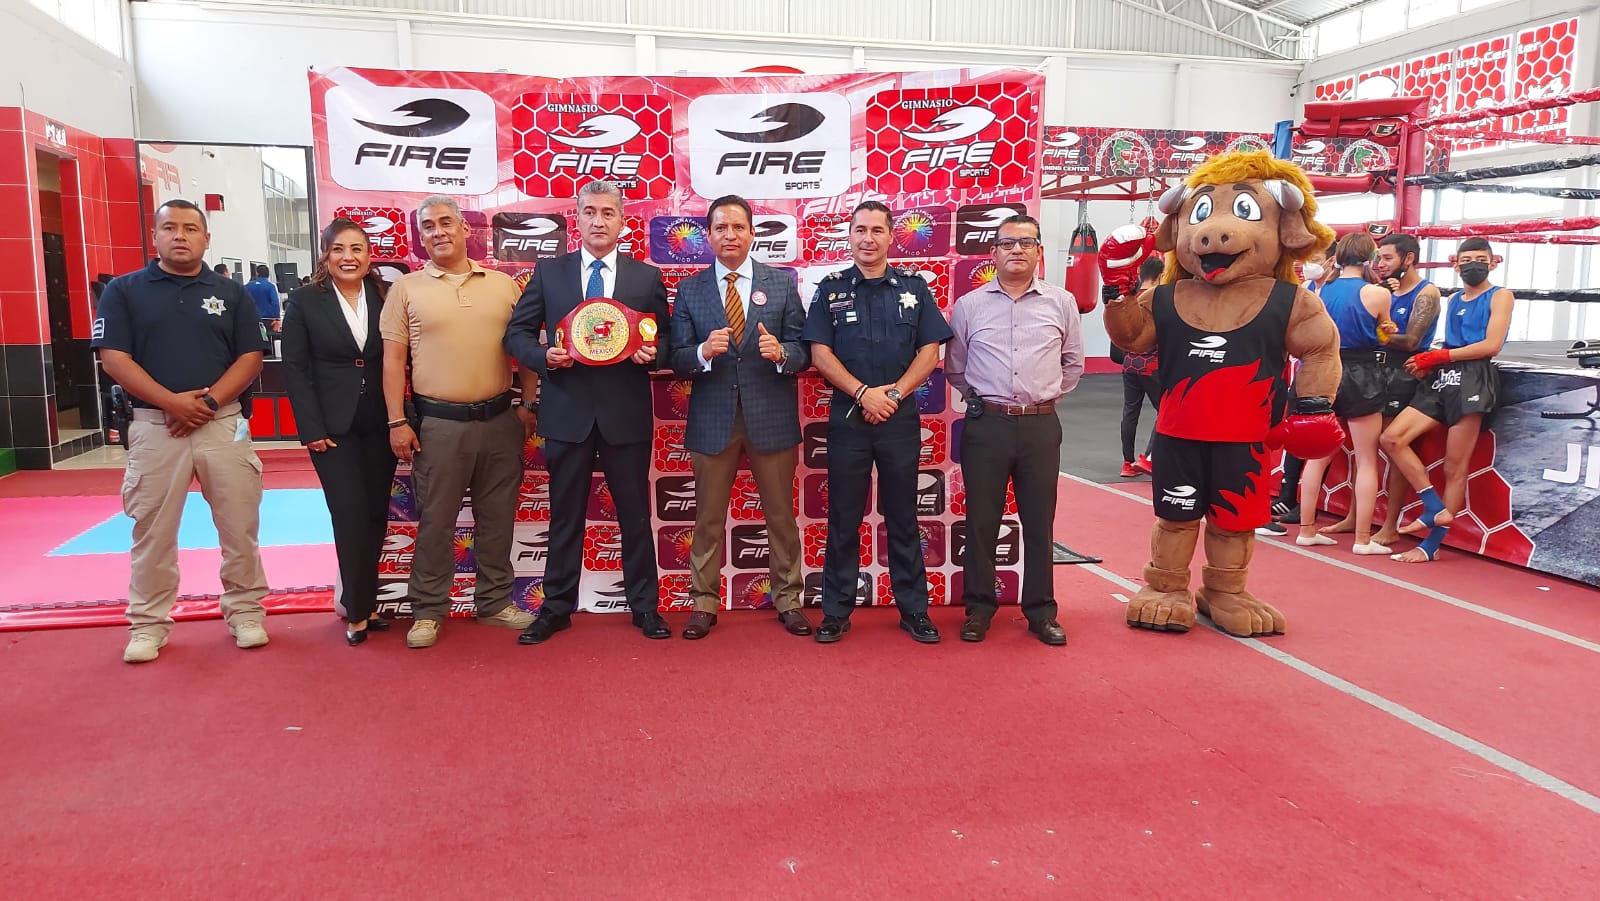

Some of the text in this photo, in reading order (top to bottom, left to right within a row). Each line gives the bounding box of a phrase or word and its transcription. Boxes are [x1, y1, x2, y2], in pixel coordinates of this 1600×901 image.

[547, 103, 598, 113] GIMNASIO
[901, 100, 953, 110] GIMNASIO
[355, 142, 472, 170] FIRE
[901, 141, 997, 170] FIRE
[1042, 149, 1081, 159] FIRE
[1169, 153, 1207, 162] FIRE
[548, 153, 643, 175] FIRE
[716, 151, 827, 175] FIRE
[959, 168, 990, 177] SPORTS
[428, 176, 466, 186] SPORTS
[785, 181, 821, 190] SPORTS
[500, 238, 559, 252] FIRE
[751, 241, 788, 252] IRE
[1188, 349, 1227, 359] FIRE
[518, 501, 551, 511] FIR
[664, 500, 697, 511] FIR
[1161, 495, 1197, 506] FIRE
[379, 553, 415, 563] IRE
[517, 550, 549, 561] FIR
[739, 547, 770, 558] FIR
[376, 602, 413, 613] IRE
